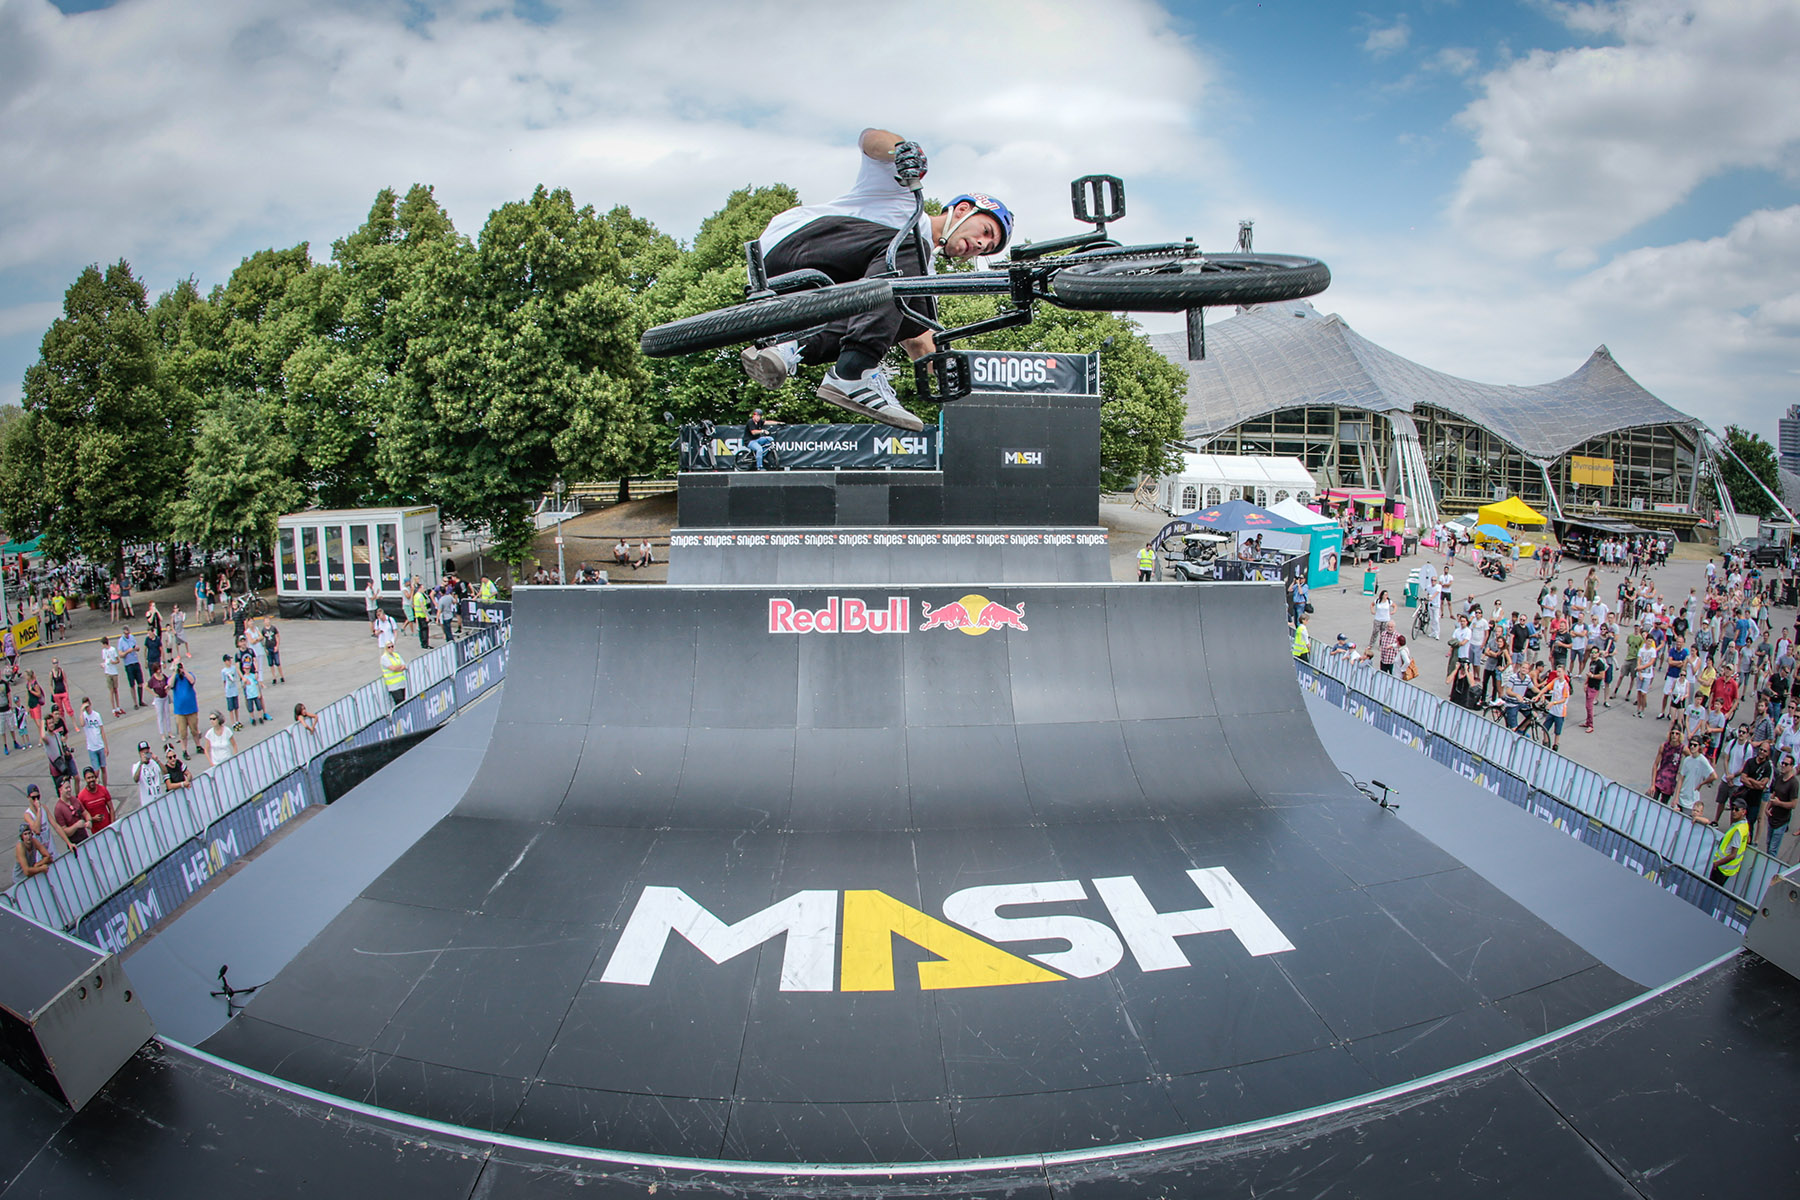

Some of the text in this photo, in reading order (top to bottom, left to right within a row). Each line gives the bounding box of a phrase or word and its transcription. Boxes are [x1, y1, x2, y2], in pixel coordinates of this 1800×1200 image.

[974, 357, 1047, 387] snipes
[874, 437, 927, 455] MASH
[1005, 452, 1042, 465] MASH
[671, 534, 1106, 547] snipes snipes snipes snipes snipes snipes snipes snipes snipes snipes snipes snipes snipes
[1244, 569, 1281, 581] MASH
[470, 608, 504, 624] MASH
[769, 596, 910, 633] Red Bull
[19, 623, 38, 645] MASH
[600, 866, 1296, 992] MASH
